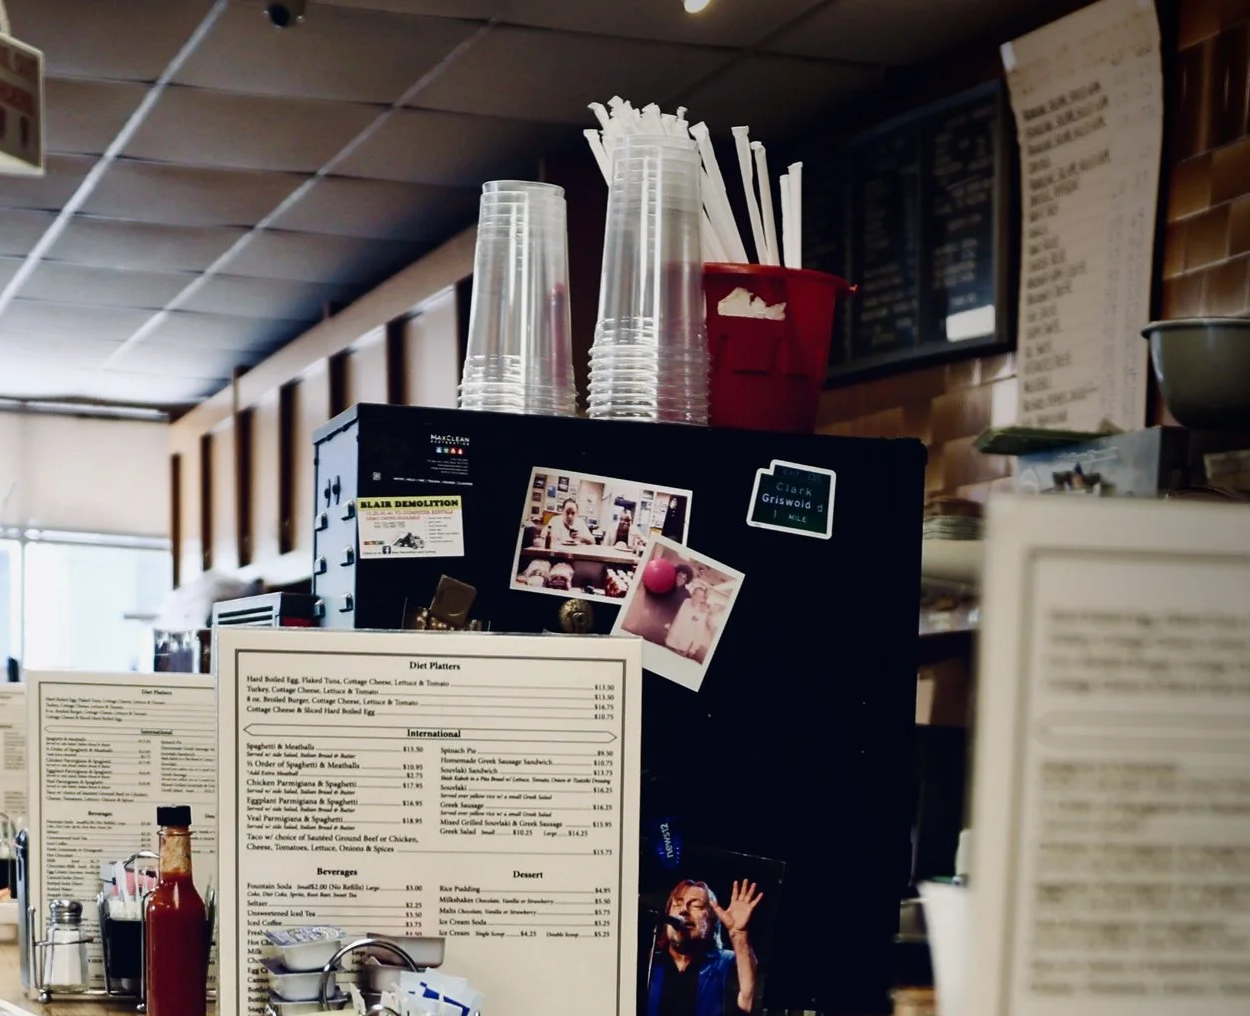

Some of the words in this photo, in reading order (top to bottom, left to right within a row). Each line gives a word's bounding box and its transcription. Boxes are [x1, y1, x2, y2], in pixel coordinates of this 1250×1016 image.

[776, 482, 812, 496] Clark
[360, 500, 392, 509] BLAIR
[395, 499, 458, 508] DEMOLITION
[762, 493, 811, 509] Griswold
[788, 514, 806, 523] MILE
[410, 661, 427, 670] Diet
[429, 662, 460, 670] Platters
[265, 676, 284, 684] Boiled
[343, 678, 367, 687] Cottage
[272, 686, 295, 695] Cottage
[355, 688, 378, 696] Tomato
[312, 697, 335, 706] Cottage
[395, 698, 418, 706] Tomato
[247, 705, 270, 714] Cottage
[342, 707, 361, 715] Boiled
[364, 708, 375, 717] Egg
[407, 729, 461, 738] International
[247, 743, 275, 752] Spaghetti
[285, 743, 314, 751] Meatballs
[441, 747, 465, 756] Spinach
[467, 747, 476, 755] Pie
[255, 760, 275, 768] Order
[287, 761, 318, 770] Spaghetti
[328, 762, 359, 770] Meatballs
[478, 757, 496, 765] Greek
[499, 758, 521, 767] Sausage
[524, 758, 552, 766] Sandwich
[247, 778, 274, 786] Chicken
[277, 779, 315, 788] Parmigiana
[326, 780, 357, 789] Spaghetti
[441, 783, 467, 791] Souvlaki
[247, 796, 276, 806] Eggplant
[279, 797, 317, 807] Parmigiana
[327, 798, 358, 807] Spaghetti
[460, 801, 483, 810] Sausage
[247, 814, 261, 822] Veal
[264, 815, 302, 824] Parmigiana
[312, 816, 343, 825] Spaghetti
[440, 818, 459, 826] Mixed
[485, 819, 510, 827] Souvlaki
[539, 820, 562, 829] Sausage
[440, 827, 458, 835] Greek
[276, 833, 297, 841] choice
[299, 833, 305, 841] of
[364, 834, 378, 842] Beef
[389, 834, 418, 843] Chicken,
[247, 843, 273, 851] Cheese,
[275, 843, 309, 852] Tomatoes,
[311, 844, 337, 852] Lettuce,
[339, 844, 364, 852] Onions
[374, 845, 394, 854] Spices
[317, 868, 358, 878] Beverages
[513, 871, 543, 879] Dessert
[248, 882, 275, 890] Fountain
[454, 885, 480, 894] Pudding
[248, 899, 267, 907] Seltzer
[248, 909, 288, 917] Unsweetened
[472, 918, 486, 926] Soda
